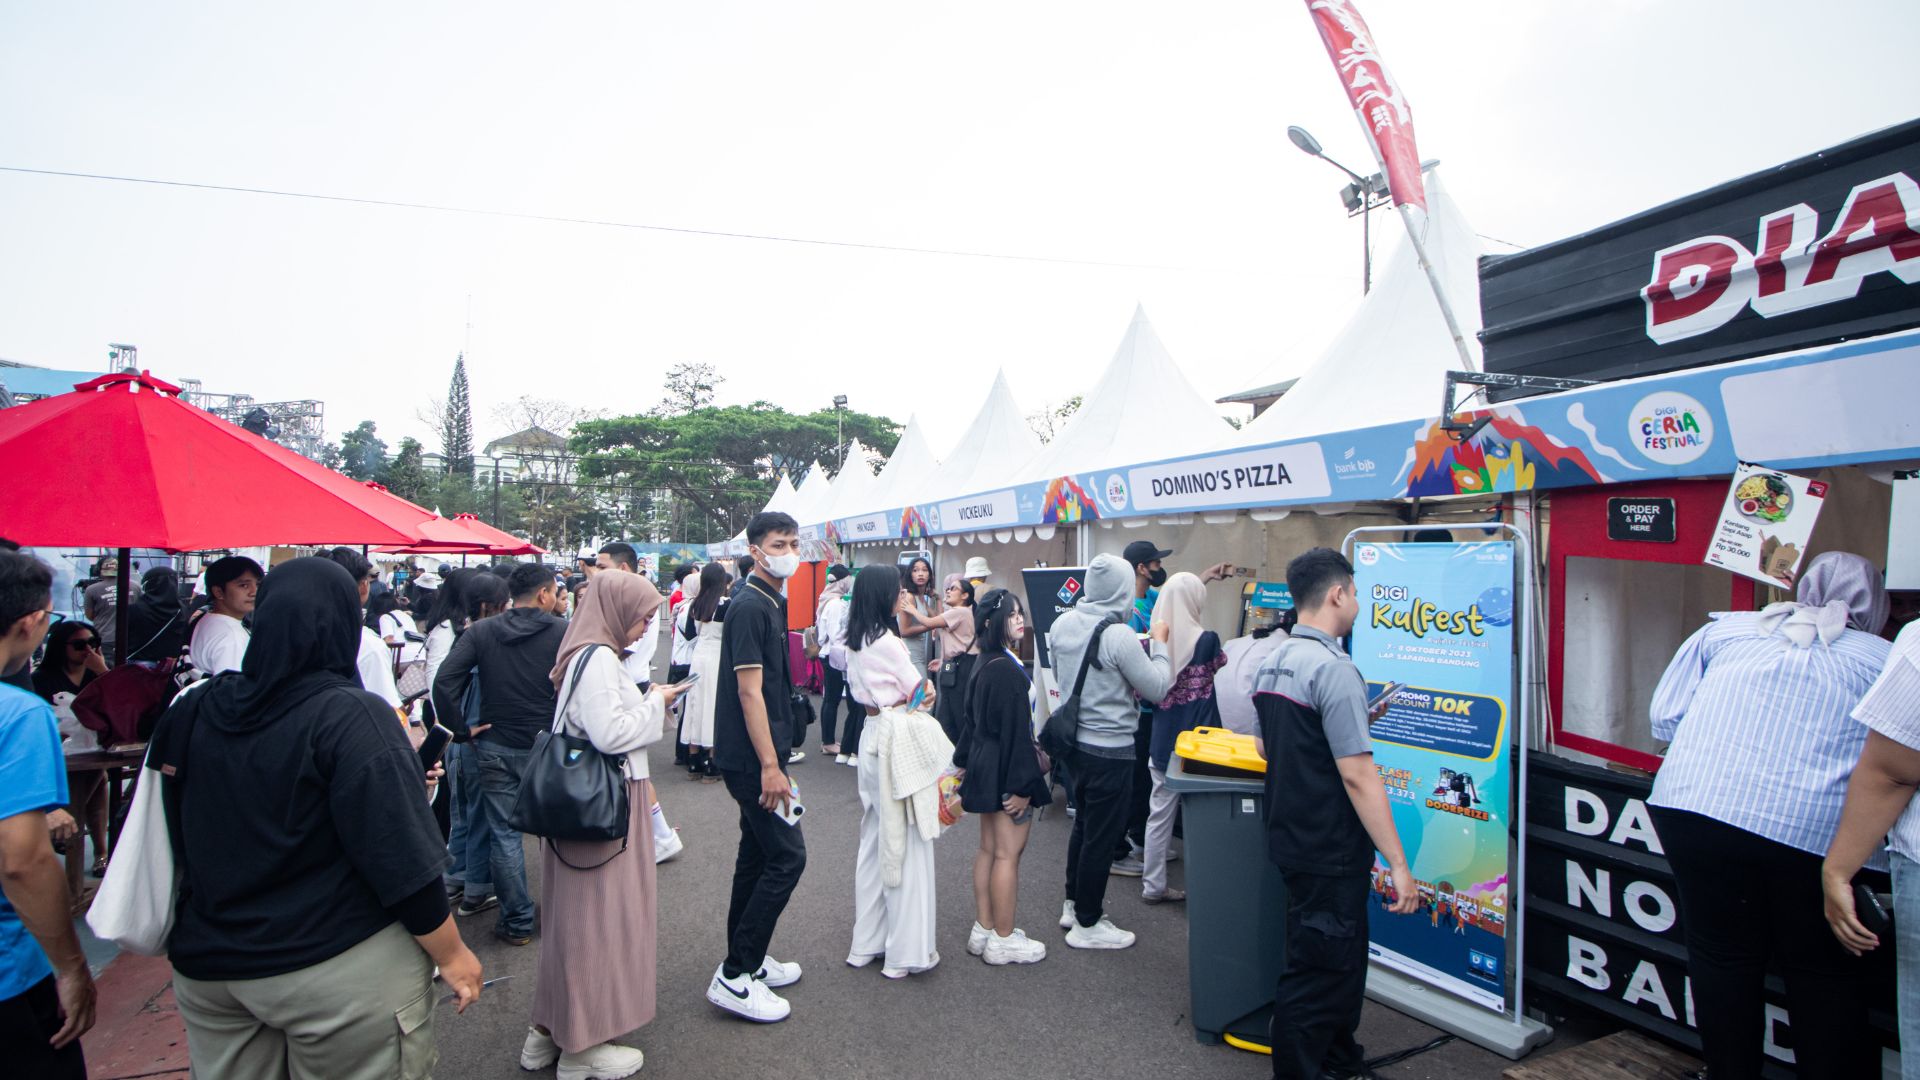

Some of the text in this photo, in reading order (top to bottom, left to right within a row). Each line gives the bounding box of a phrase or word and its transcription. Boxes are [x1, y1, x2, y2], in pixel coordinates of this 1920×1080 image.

[1334, 459, 1376, 474] bank bjb
[1151, 462, 1292, 497] DOMINO'S PIZZA
[958, 503, 993, 520] VICKEUKU
[1620, 504, 1660, 515] ORDER
[1634, 514, 1655, 524] PAY
[1630, 524, 1651, 532] HERE
[1715, 542, 1726, 551] Rp
[1372, 584, 1408, 601] DIGI
[1372, 597, 1484, 638] Kulfest
[1405, 646, 1447, 656] OKTOBER
[1449, 650, 1472, 658] 2023
[1397, 654, 1436, 664] SAPARUA
[1437, 658, 1480, 668] BANDUNG
[1390, 697, 1431, 709] ISCOUNT
[1396, 691, 1431, 702] PROMO
[1433, 696, 1475, 717] 10K
[1426, 798, 1489, 821] DOORPRIZE
